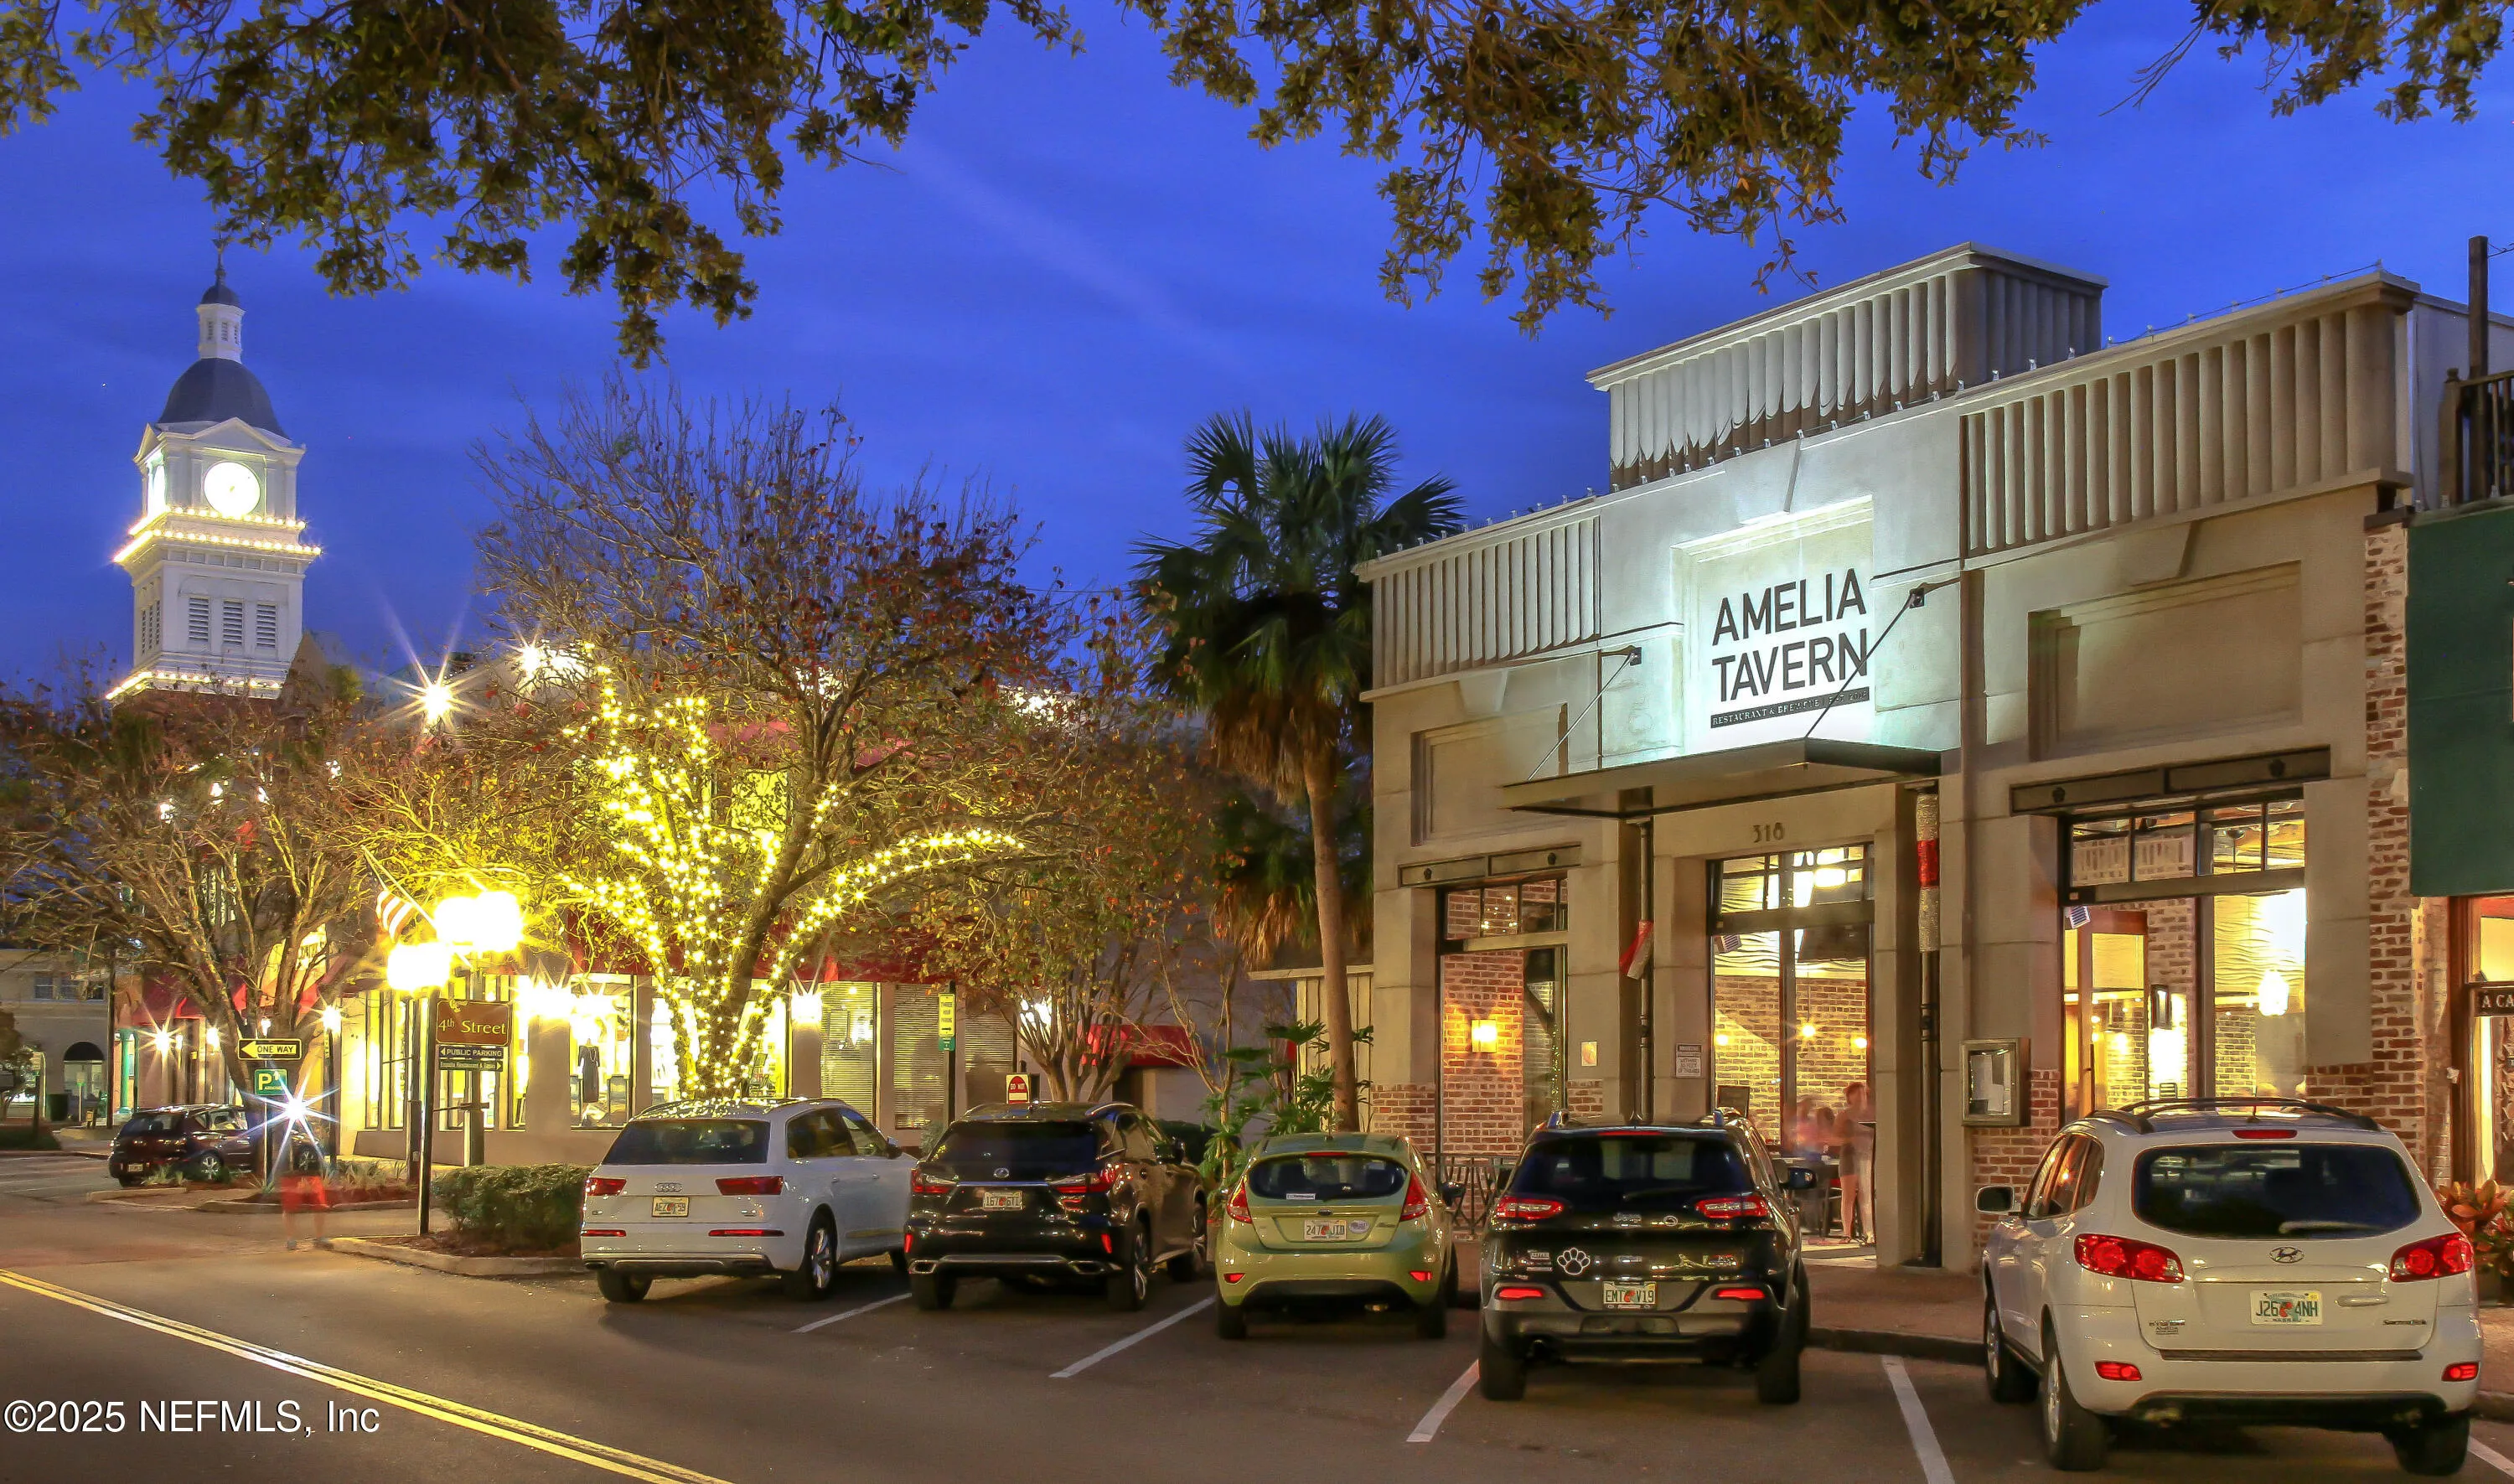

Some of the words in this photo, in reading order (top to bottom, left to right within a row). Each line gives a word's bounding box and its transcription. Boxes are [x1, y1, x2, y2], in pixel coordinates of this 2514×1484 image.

[1712, 567, 1867, 647] AMELIA
[1712, 628, 1868, 702] TAVERN
[1712, 708, 1767, 726] RESTAURANT
[2482, 994, 2492, 1008] A
[437, 1017, 455, 1032] 4th
[461, 1020, 506, 1035] Street
[256, 1045, 273, 1053] ONE
[277, 1045, 294, 1053] WAY
[472, 1048, 502, 1057] PARKING
[258, 1073, 272, 1091] P
[1606, 1290, 1624, 1303] EMT
[1636, 1290, 1654, 1303] V19
[2256, 1300, 2279, 1317] J26
[2294, 1300, 2319, 1317] 4NH
